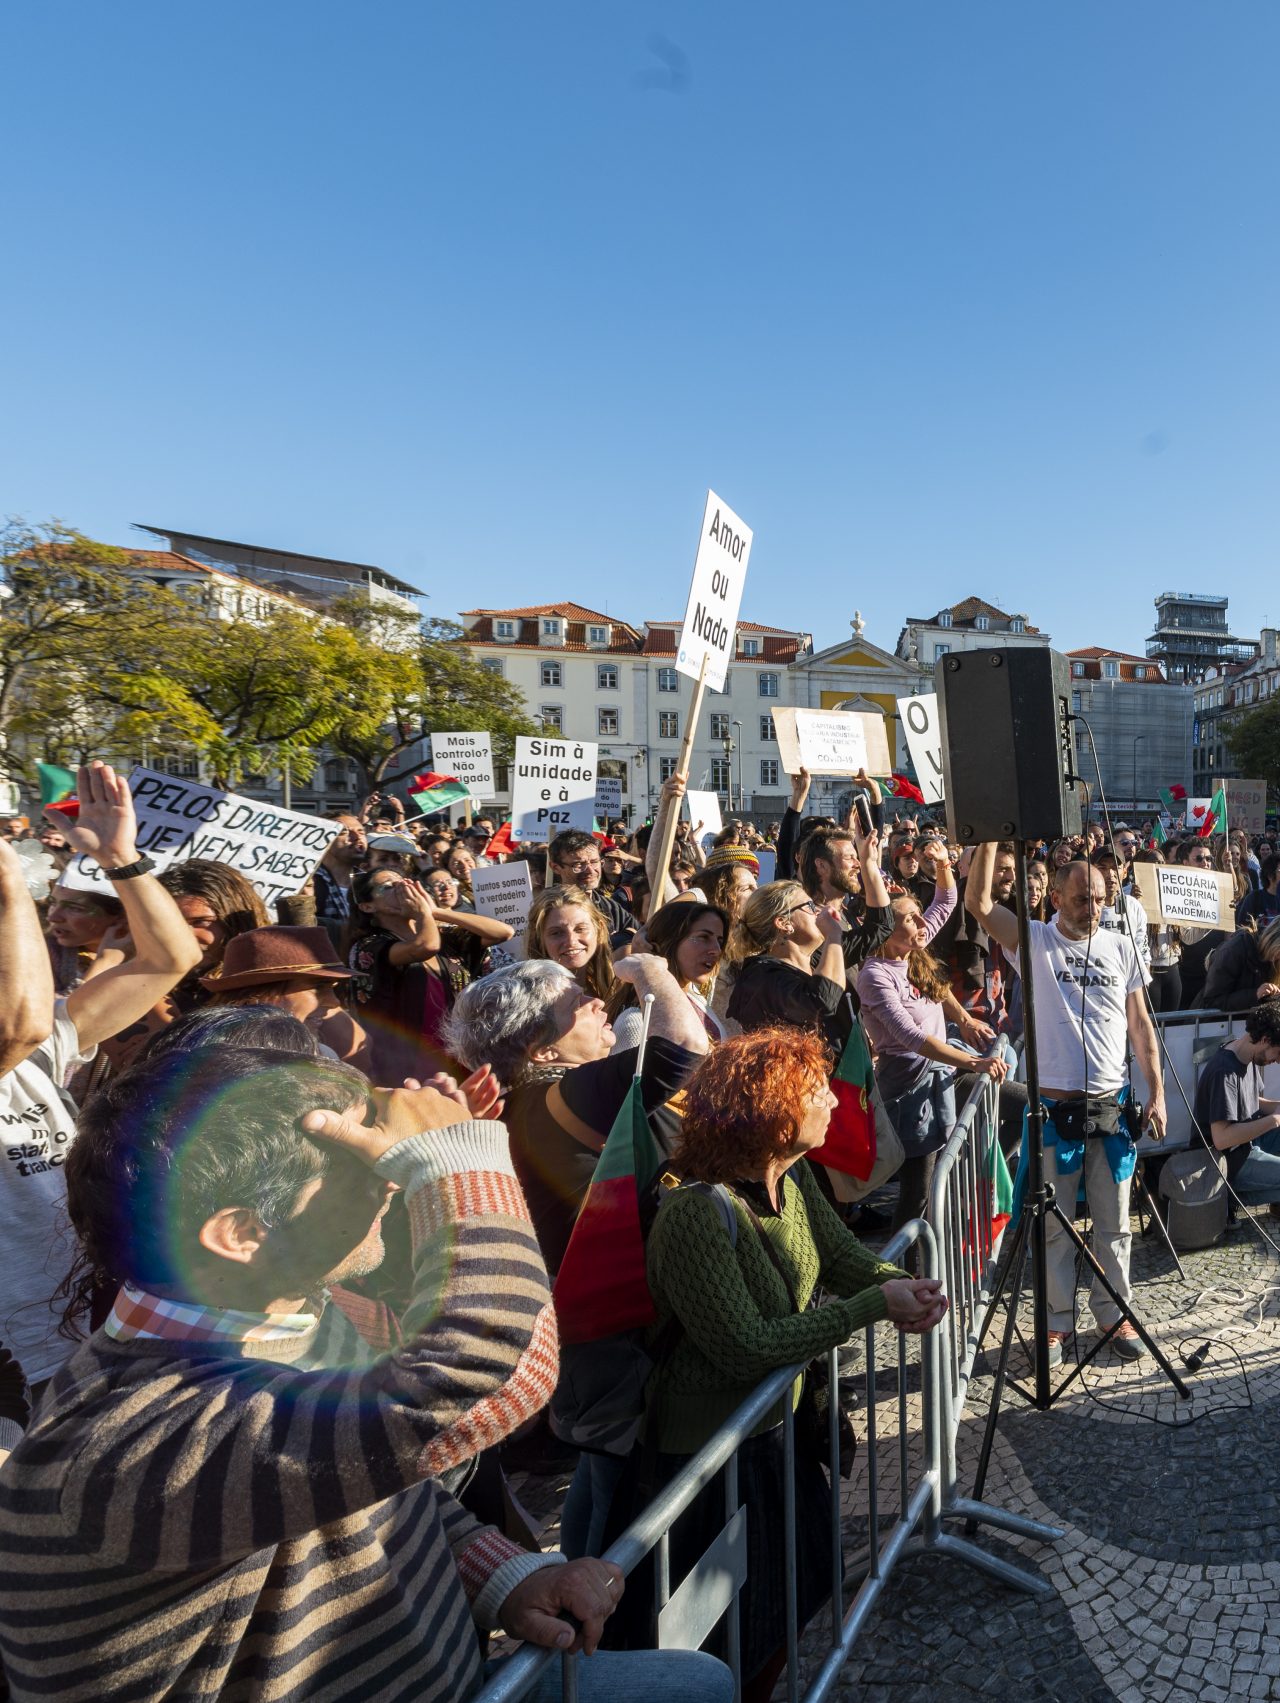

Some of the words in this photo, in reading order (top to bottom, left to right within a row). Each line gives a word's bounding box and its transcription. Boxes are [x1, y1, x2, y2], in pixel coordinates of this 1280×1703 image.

[709, 508, 746, 563] Amor
[711, 569, 729, 601] ou
[691, 602, 729, 652] Nada
[447, 737, 476, 746] Mais
[529, 740, 566, 758] Sim
[573, 743, 584, 759] à
[435, 748, 489, 759] controlo?
[452, 761, 475, 771] Não
[518, 763, 593, 782] unidade
[540, 789, 551, 801] e
[558, 786, 569, 802] à
[132, 776, 230, 823] PELOS
[222, 804, 338, 851] DIREITOS
[594, 802, 620, 810] oração
[537, 808, 570, 824] Paz
[136, 820, 183, 854] UE
[238, 845, 317, 880] SABES
[475, 881, 500, 892] Juntos
[501, 877, 526, 887] somos
[1161, 872, 1218, 892] PECUÁRIA
[480, 896, 485, 904] o
[486, 890, 526, 903] verdadeiro
[1162, 885, 1218, 902] INDUSTRIAL
[494, 904, 519, 916] poder.
[1183, 898, 1202, 908] CRIA
[1165, 904, 1217, 921] PANDEMIAS
